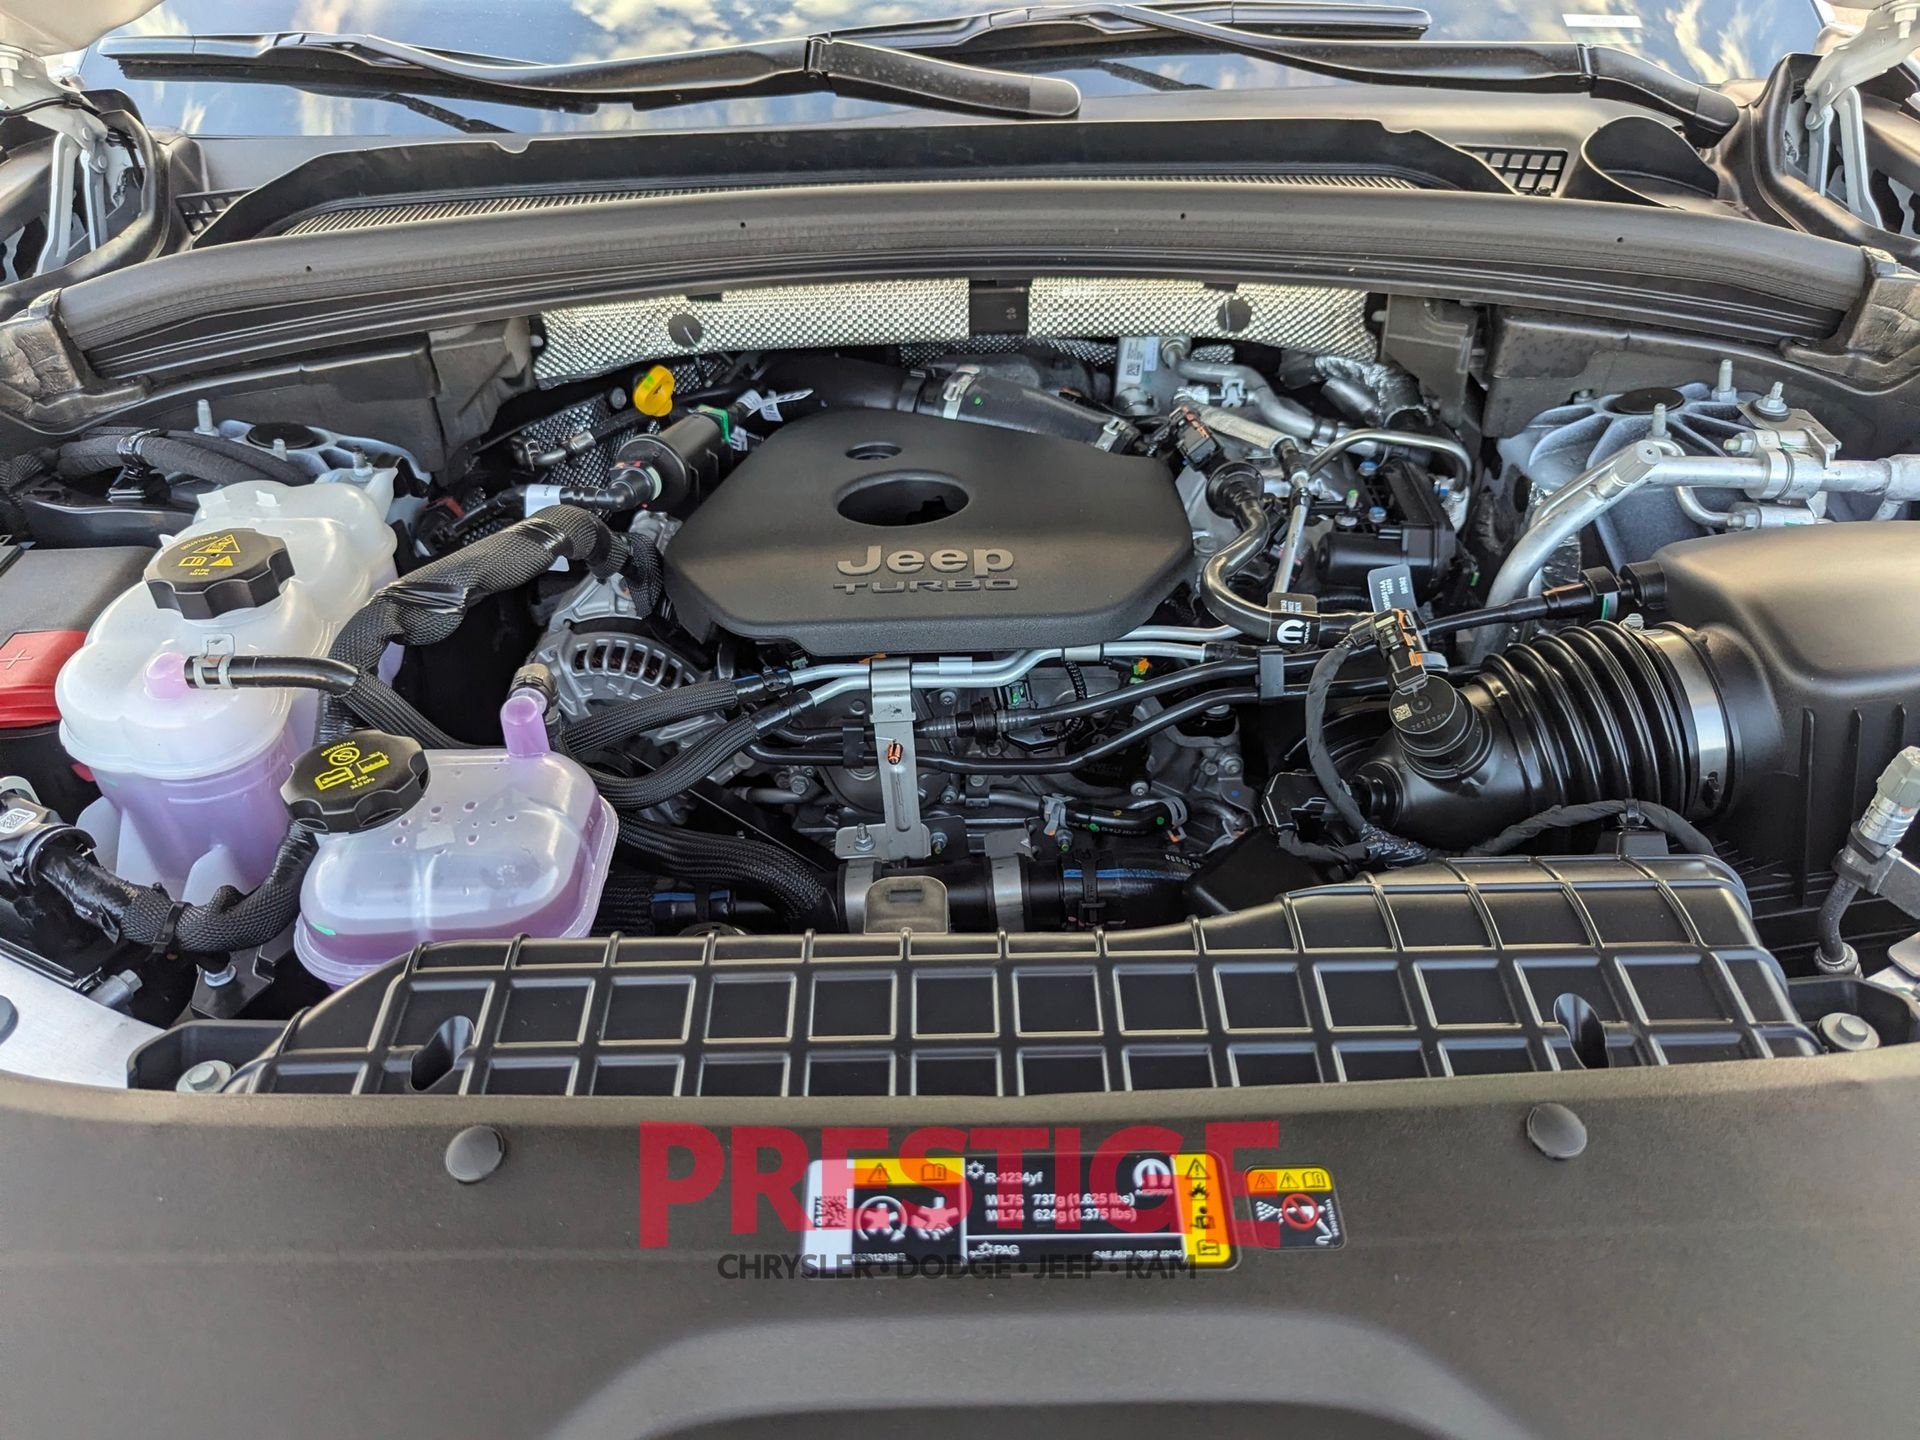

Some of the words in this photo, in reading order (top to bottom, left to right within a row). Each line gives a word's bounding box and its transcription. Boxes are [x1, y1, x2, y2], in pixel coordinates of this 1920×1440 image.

[837, 545, 1014, 578] Jeep
[833, 579, 1018, 595] TURBO
[985, 1171, 1043, 1187] R-1234yf
[985, 1194, 1024, 1206] WL75
[985, 1209, 1025, 1222] WL74
[994, 1244, 1020, 1256] PAG
